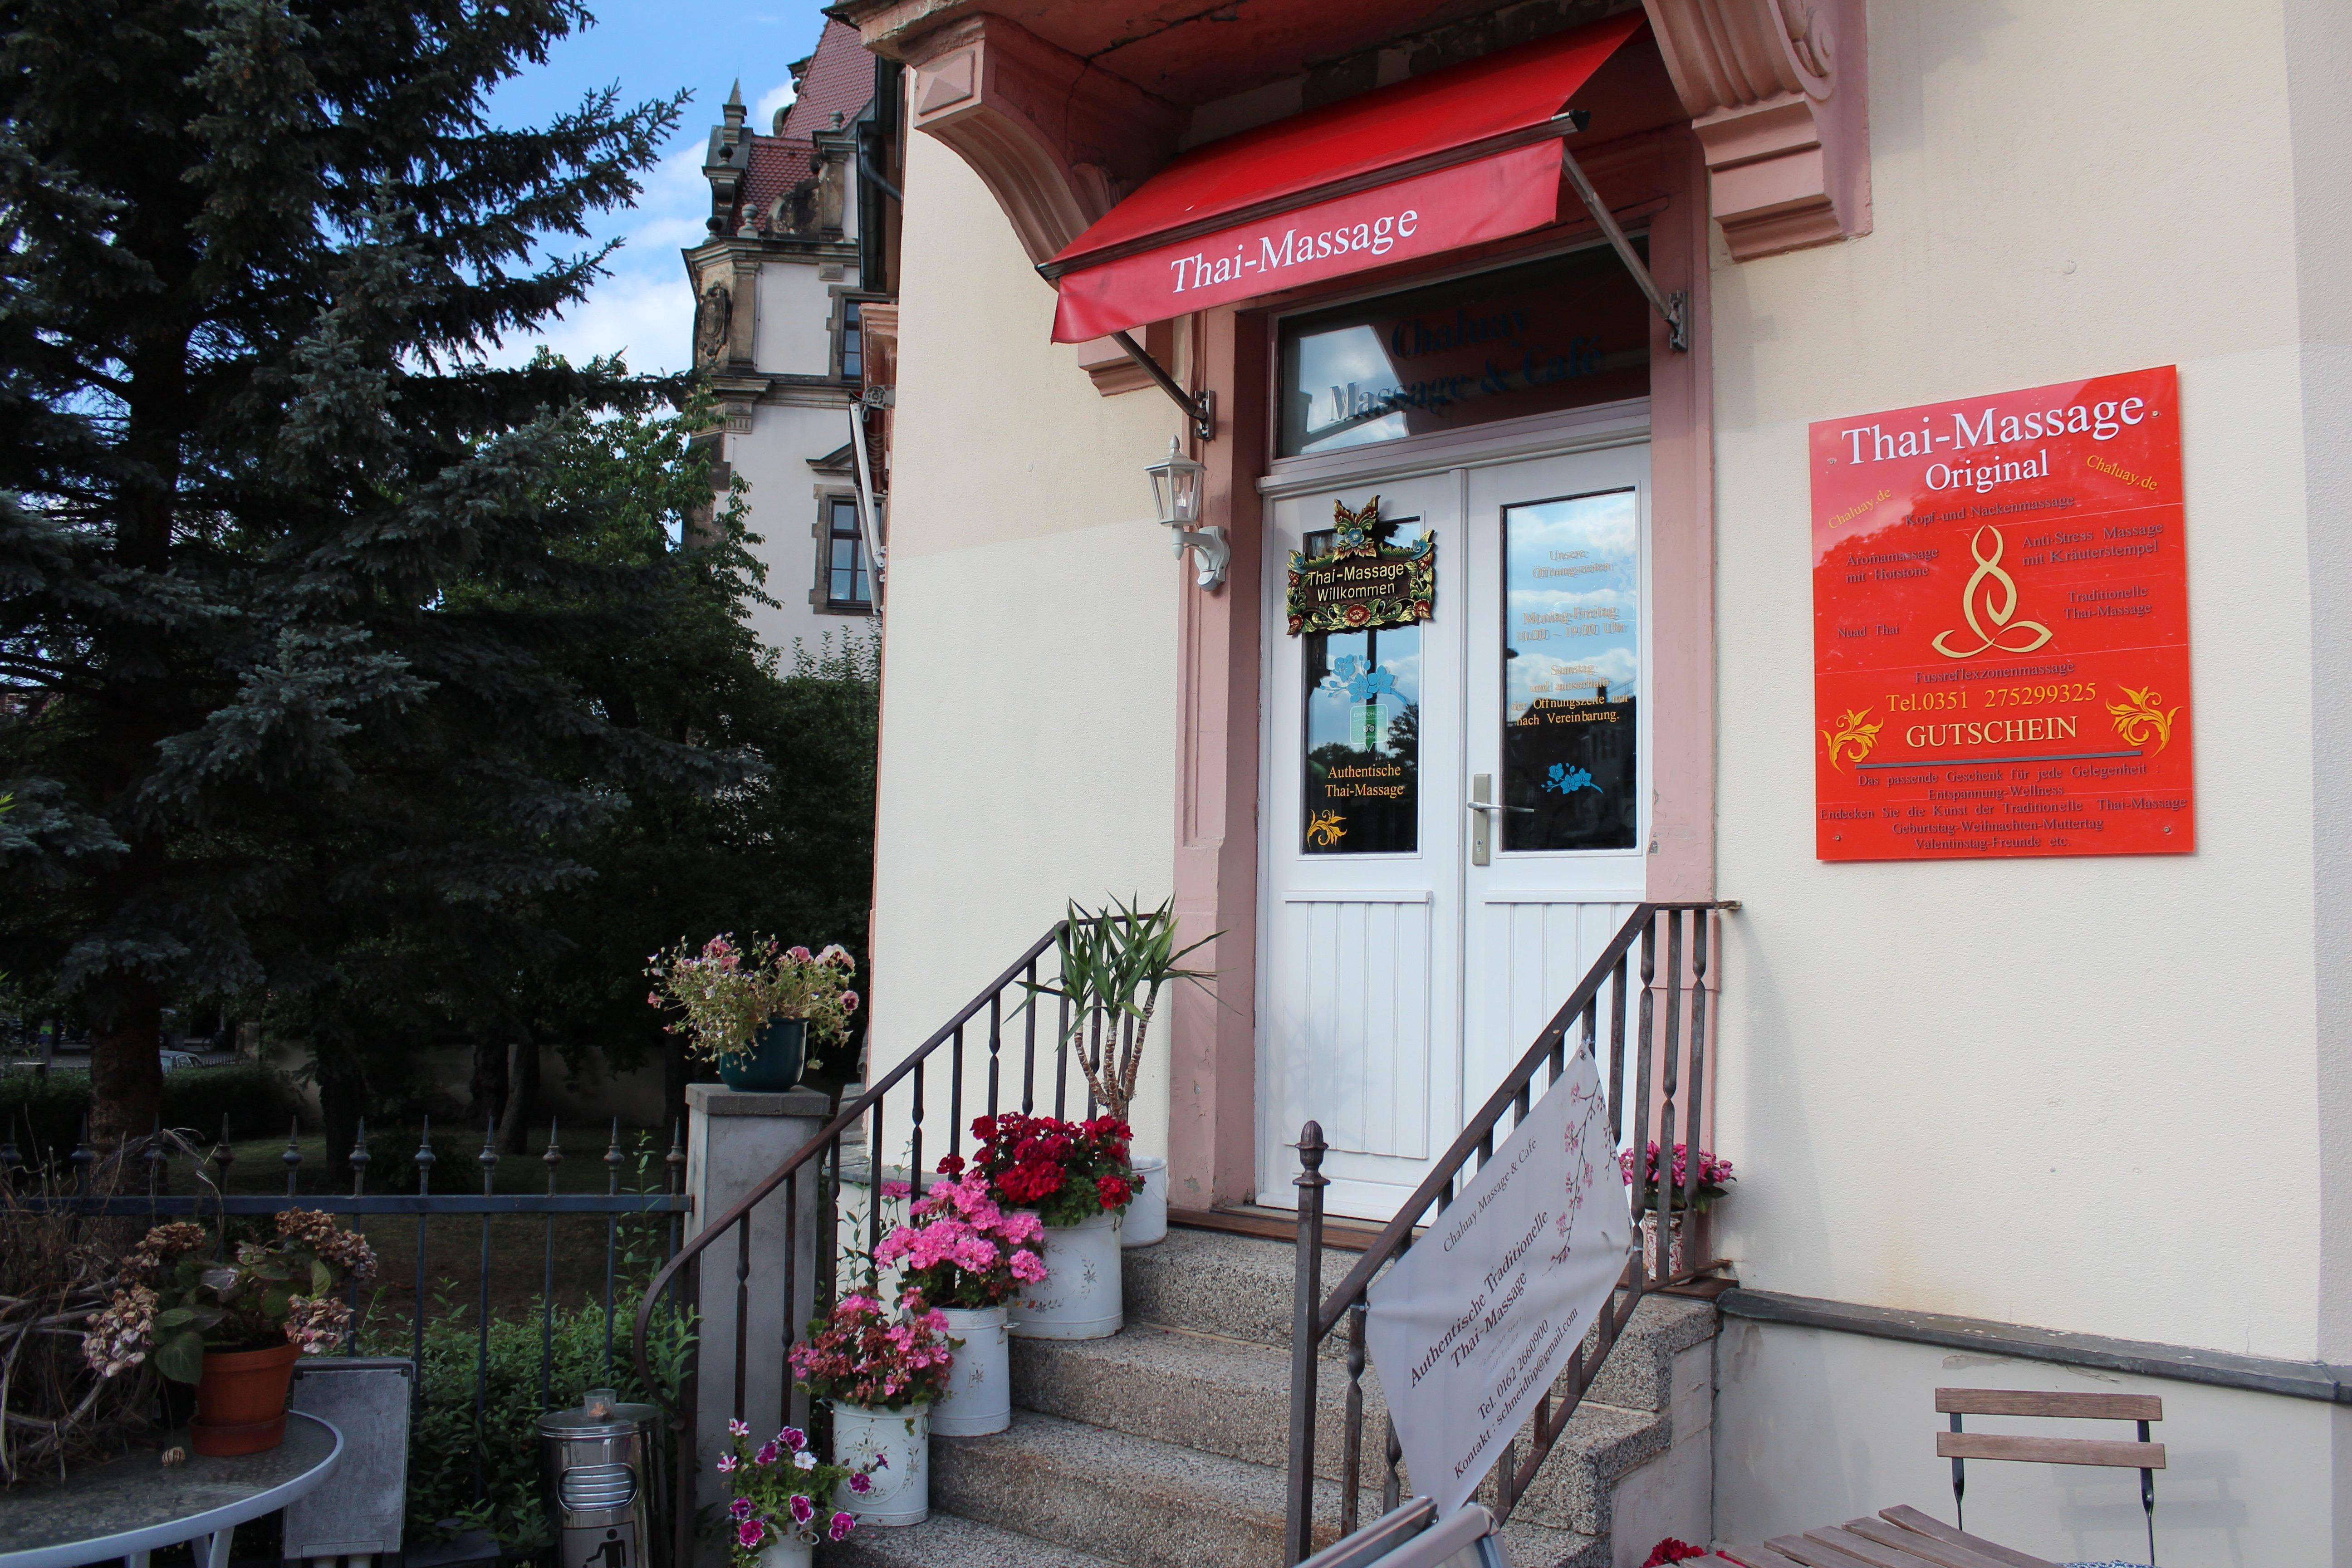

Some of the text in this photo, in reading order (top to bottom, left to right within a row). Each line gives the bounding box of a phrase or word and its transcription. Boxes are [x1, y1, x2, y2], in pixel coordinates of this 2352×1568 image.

[1170, 209, 1418, 294] Thai-Massage
[1392, 306, 1530, 358] Chaluay
[1328, 334, 1603, 422] Massage & Café
[1842, 396, 2144, 465] Thai-Massage
[1926, 449, 2050, 493] Original
[2087, 455, 2158, 490] Chaluay.de
[1828, 488, 1891, 529] Chaluay.de
[1970, 495, 2074, 518] Nackenmassage
[2022, 523, 2164, 549] Anti-Stress Massage
[1549, 549, 1587, 562] Unsere
[1846, 549, 1939, 567] Aromamassage
[2022, 539, 2158, 566] mit Kräuterstempel
[1308, 564, 1404, 586] Thai-Massage
[1846, 566, 1930, 583] mit Hotstone
[1318, 583, 1395, 601] Willkommen
[2067, 585, 2148, 603] Traditionelle
[1523, 606, 1618, 625] Montag-Freitag
[2063, 603, 2152, 620] Thai-Massage
[1602, 622, 1626, 634] Uhr
[1837, 623, 1900, 638] Nuad Thai
[1551, 664, 1596, 676] Samstag
[1915, 662, 2074, 684] Fussreflexzonenmassage
[1530, 677, 1610, 692] und ausserhalb
[1511, 701, 1527, 711] der
[1612, 695, 1629, 704] nur
[1886, 682, 2096, 712] Tel.0351 275299325
[1517, 711, 1619, 726] nach Vereinbarung.
[1906, 715, 2078, 748] GUTSCHEIN
[1328, 763, 1401, 779] Authentische
[1857, 774, 1879, 786] Das
[1886, 772, 1938, 788] passende
[1945, 769, 2003, 782] Geschenk
[2010, 768, 2029, 780] für
[2036, 766, 2062, 782] jede
[2071, 763, 2146, 779] Gelegenheit
[1325, 783, 1403, 799] Thai-Massage
[1927, 784, 2064, 802] Entspannung-Wellness
[1819, 797, 2187, 820] Endecken Sie die Kunst der Traditionelle Thai-Massage
[1892, 818, 2103, 835] Geburtstag-Weihnachten-Muttertag
[1914, 835, 2070, 851] Valentinstag-Freunde etc.
[1444, 1136, 1538, 1253] Chaluay Massage & Café
[1411, 1294, 1487, 1389] Authentische
[1484, 1211, 1548, 1294] Traditionelle
[1451, 1272, 1526, 1368] Thai-Massage
[1477, 1397, 1497, 1420] Tel.
[1497, 1367, 1518, 1398] 0162
[1518, 1320, 1549, 1372] 2660900
[1454, 1429, 1491, 1480] Kontakt
[1497, 1308, 1578, 1426] schneidtip@gmail.com
